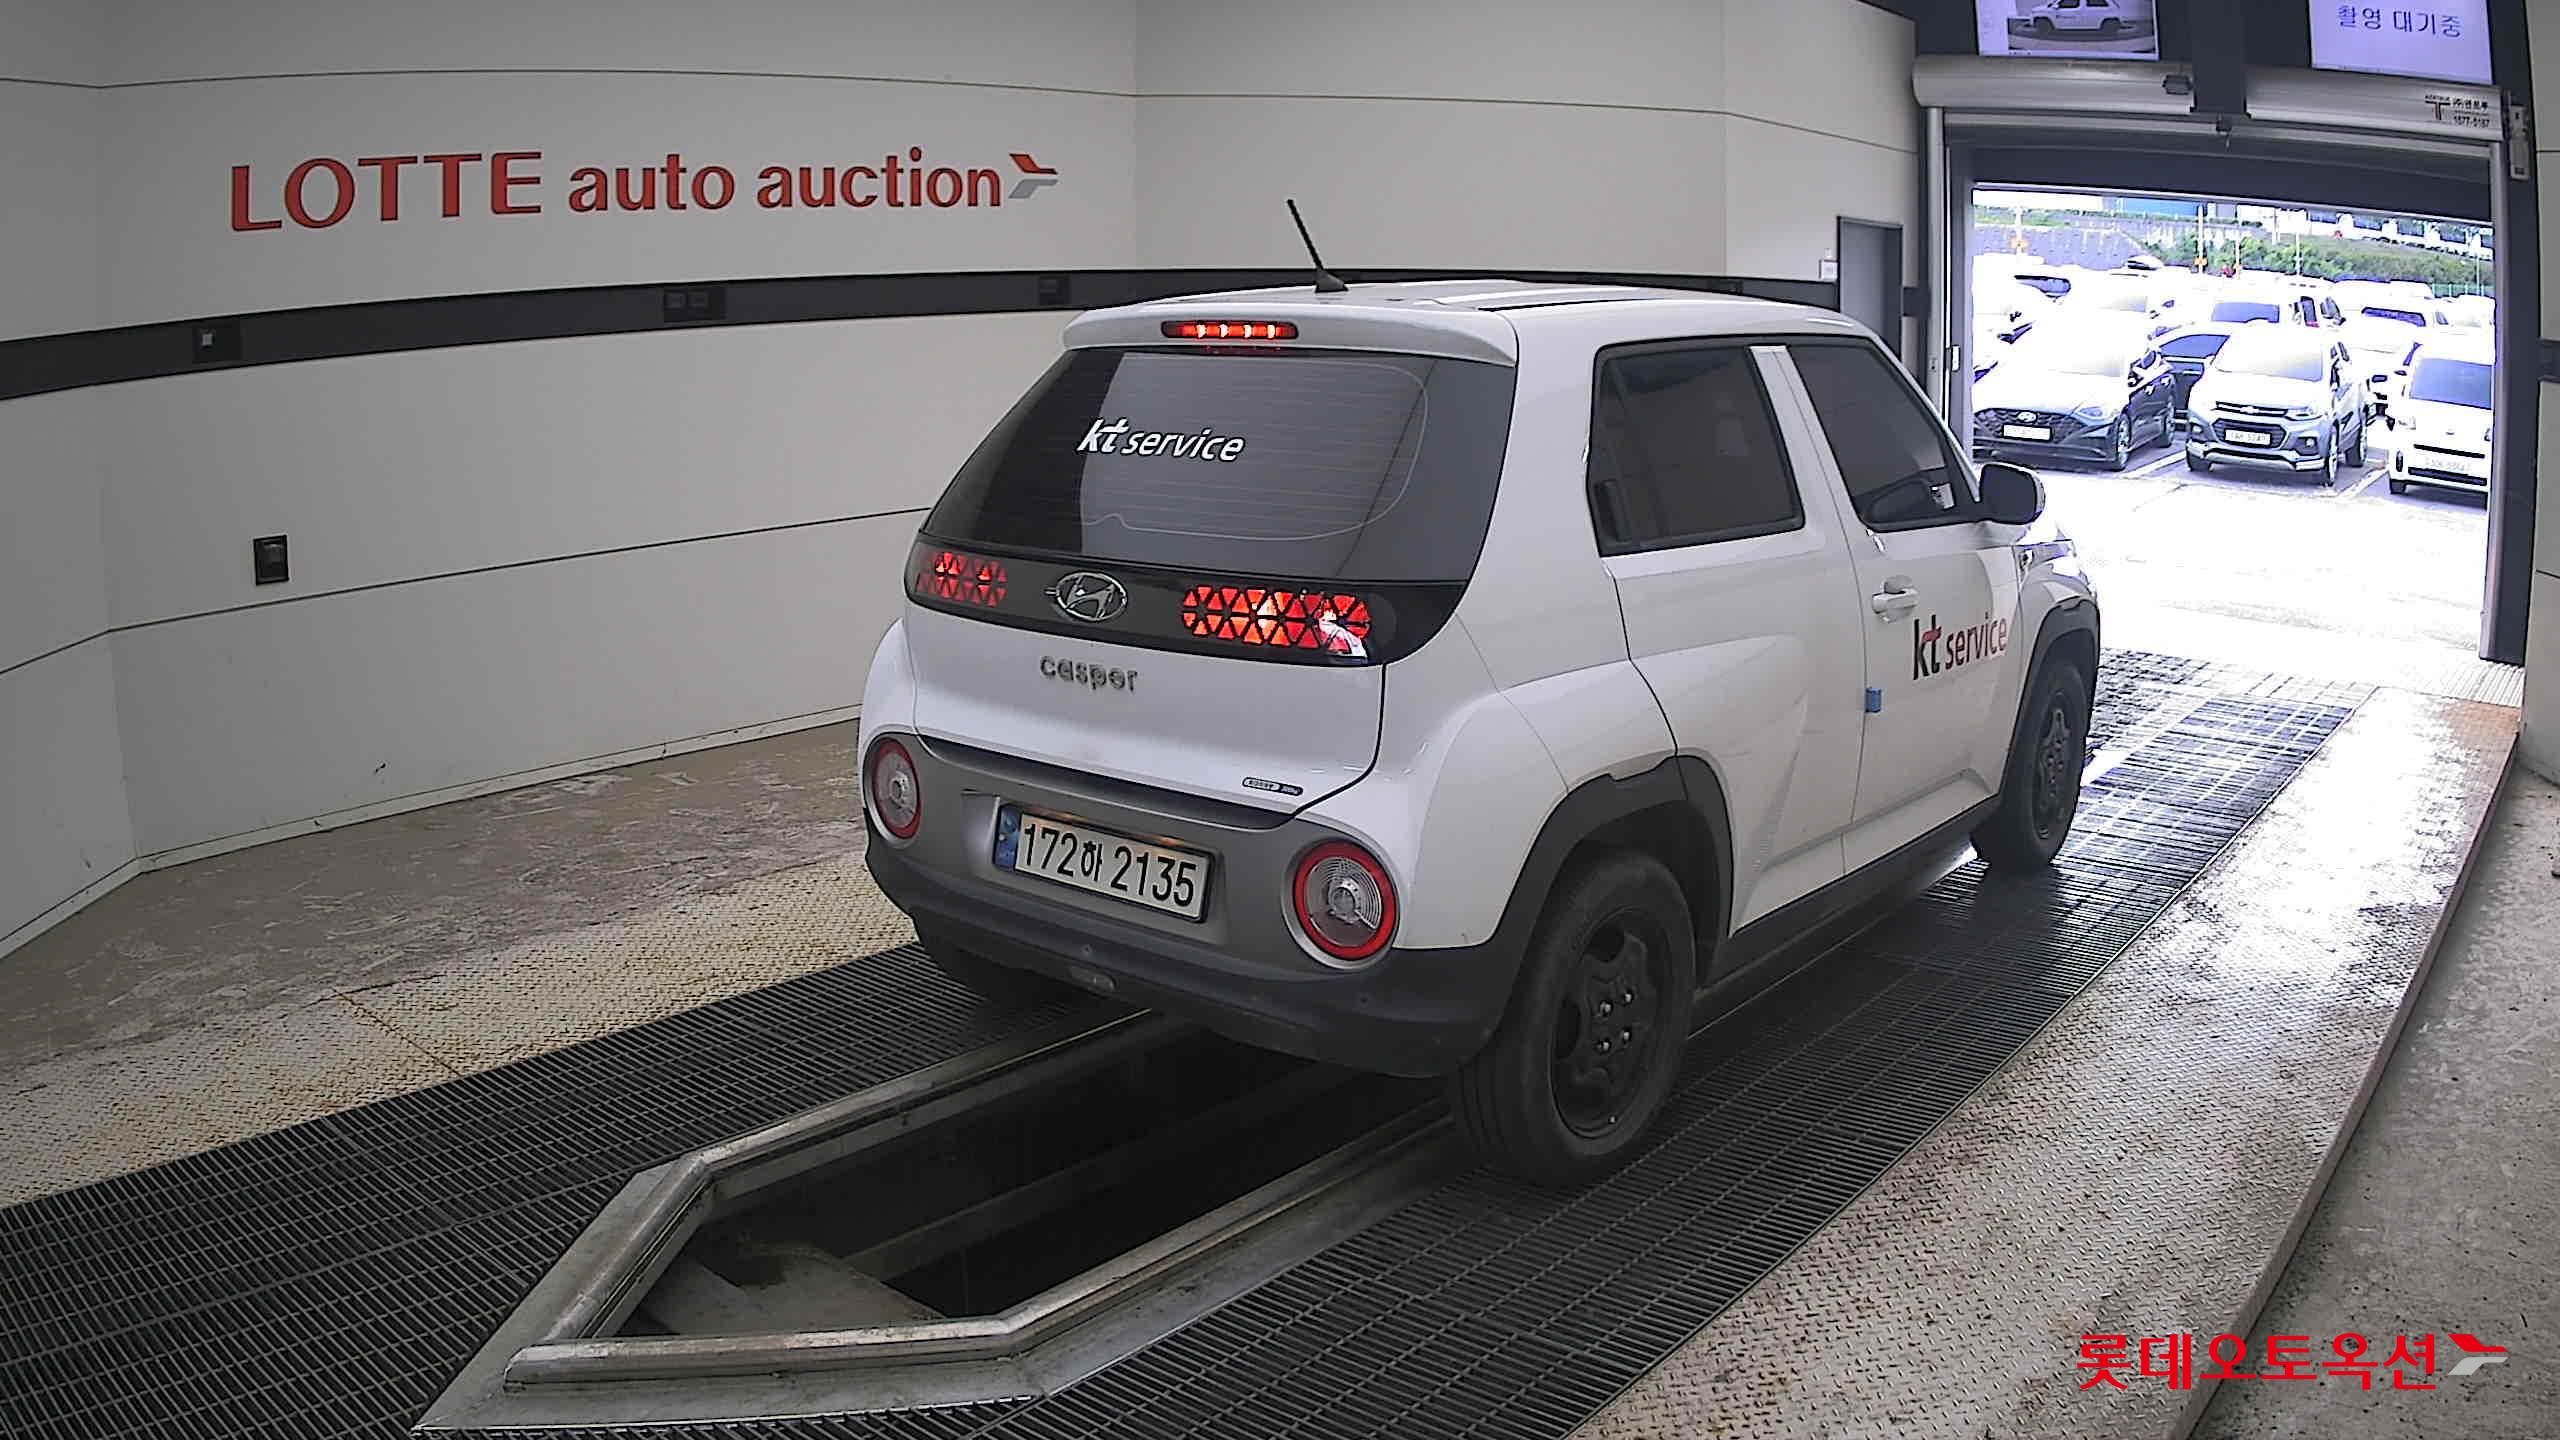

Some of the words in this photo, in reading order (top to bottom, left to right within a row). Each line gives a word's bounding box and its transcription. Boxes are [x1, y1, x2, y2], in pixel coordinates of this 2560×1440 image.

[2338, 5, 2382, 30] 촬영
[2393, 11, 2461, 38] 대기중
[231, 151, 542, 231] LOTTE
[568, 154, 736, 213] auto
[757, 146, 1002, 209] auction
[1077, 418, 1129, 452] kt
[1121, 429, 1245, 461] service
[1913, 614, 1942, 680] kt
[1945, 611, 2007, 670] service
[1040, 656, 1138, 692] casper
[1024, 823, 1104, 882] 172하
[1110, 846, 1197, 908] 2135
